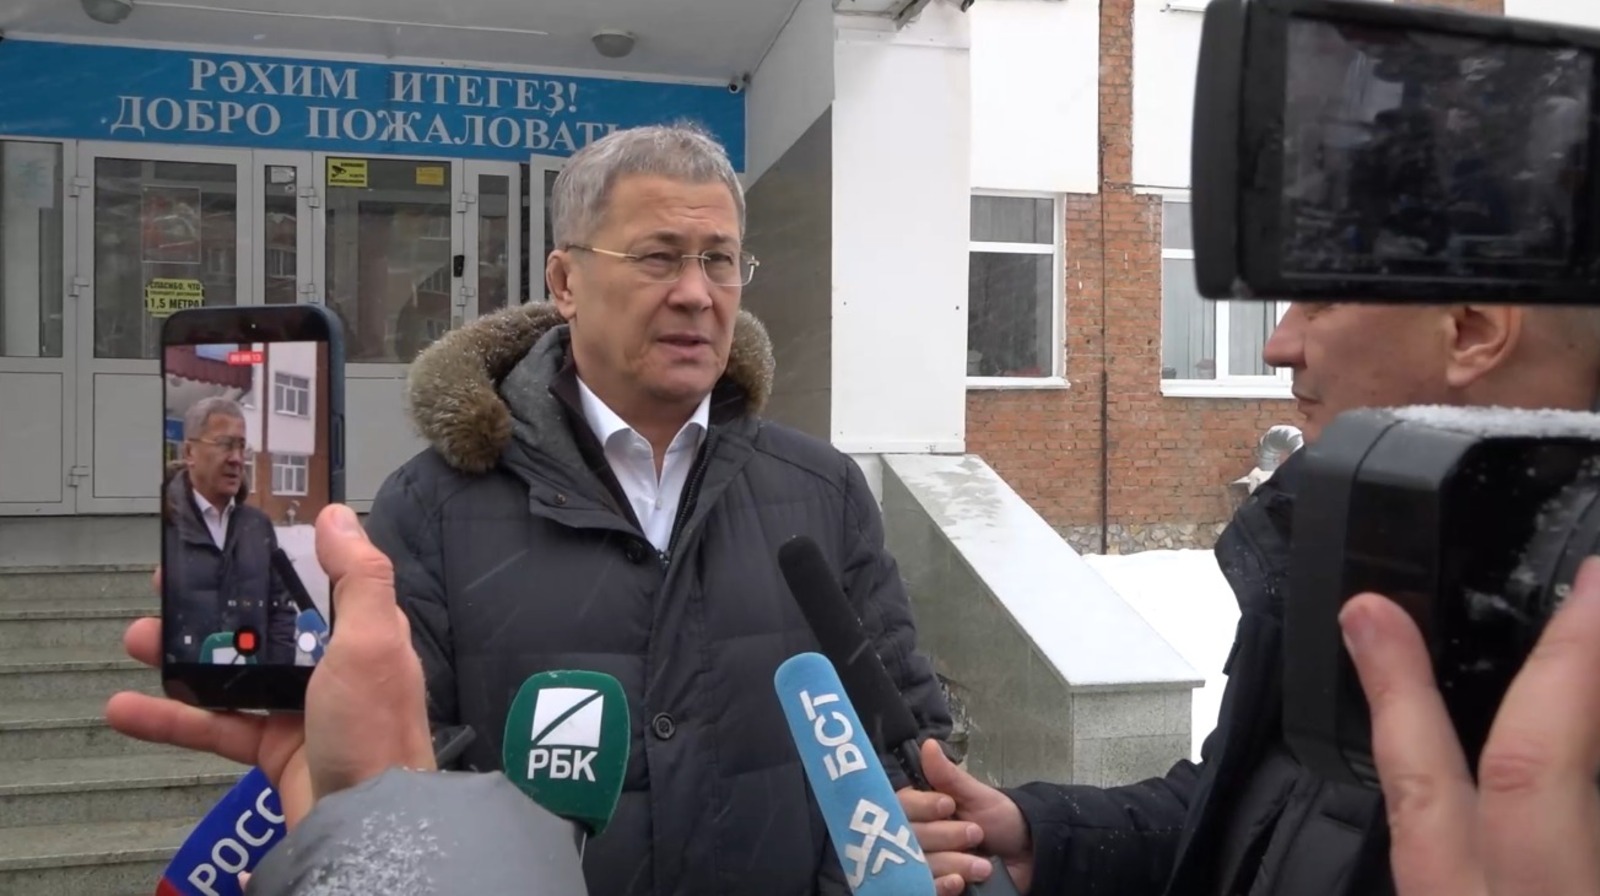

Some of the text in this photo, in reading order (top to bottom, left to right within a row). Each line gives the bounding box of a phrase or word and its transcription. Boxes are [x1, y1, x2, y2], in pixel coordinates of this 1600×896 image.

[189, 58, 577, 117] РӘХИМ ИТЕГЕҘ!
[110, 96, 281, 137] ДОБРО
[151, 298, 166, 309] 1,5
[800, 690, 867, 780] БСТ
[528, 748, 598, 782] РБК
